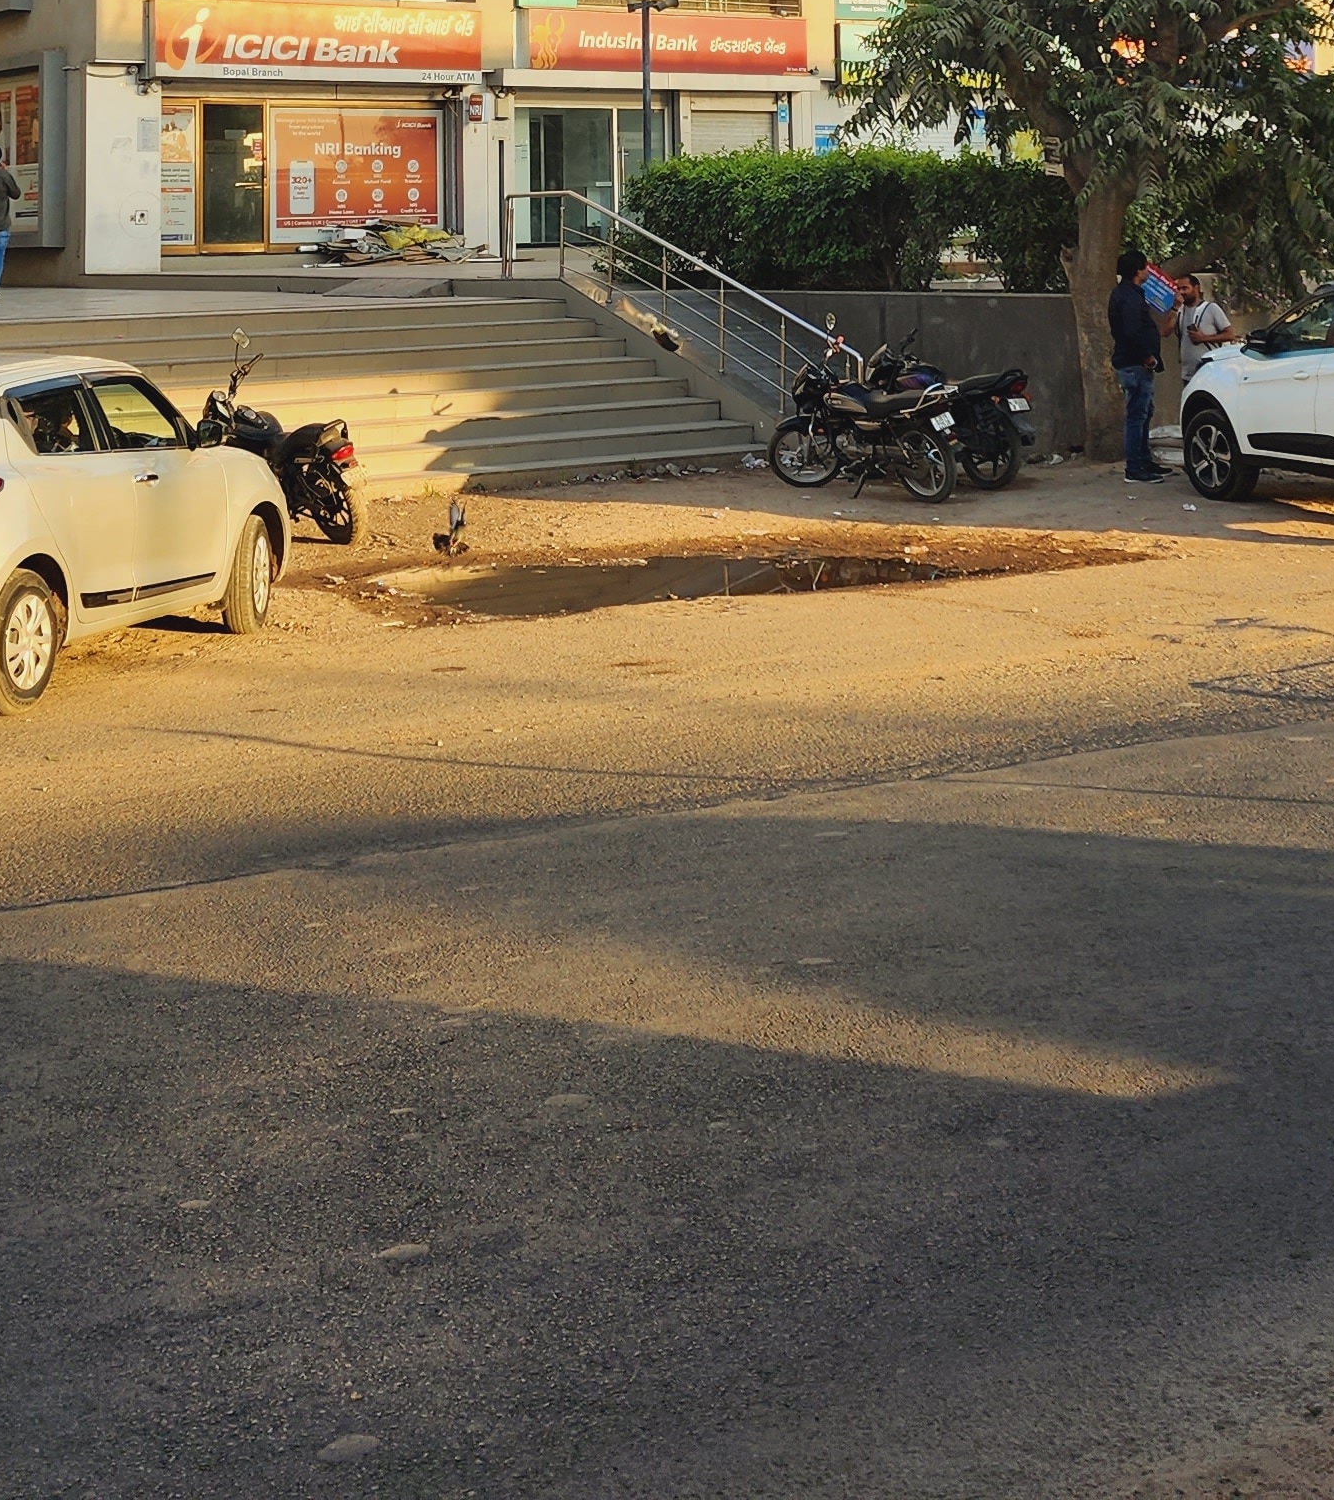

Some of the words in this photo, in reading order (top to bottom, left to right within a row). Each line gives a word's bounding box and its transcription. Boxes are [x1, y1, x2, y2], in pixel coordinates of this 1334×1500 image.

[223, 34, 307, 61] ICICI
[314, 37, 400, 64] Bank
[656, 34, 698, 52] Bank
[223, 66, 250, 78] Bopal
[252, 67, 283, 77] Branch
[421, 72, 432, 80] 24
[434, 73, 454, 82] Hour
[456, 73, 475, 82] ATM
[469, 104, 482, 116] NRI
[315, 143, 339, 155] NRI
[344, 143, 401, 158] Banking
[291, 176, 312, 184] 320+
